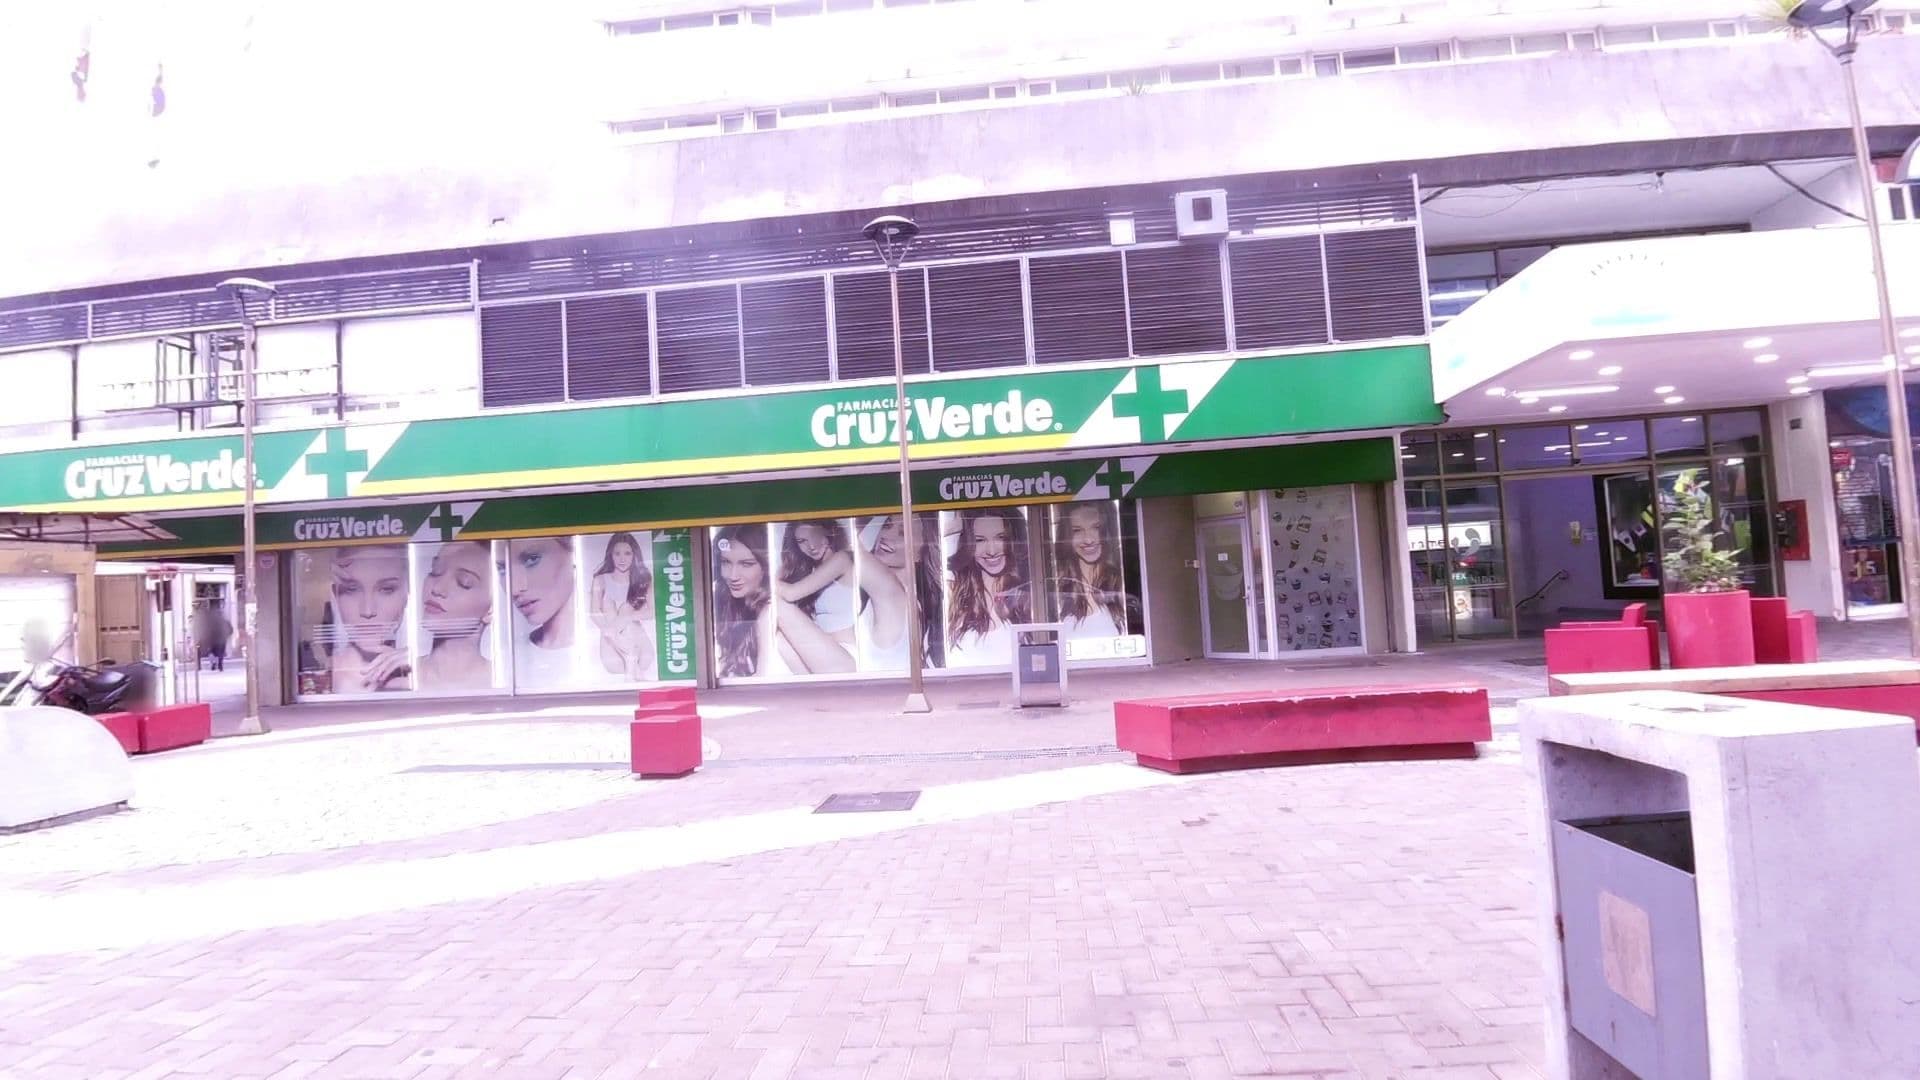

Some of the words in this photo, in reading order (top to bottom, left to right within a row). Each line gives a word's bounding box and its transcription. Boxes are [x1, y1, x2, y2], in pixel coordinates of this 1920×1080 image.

[914, 390, 1053, 440] Verde
[64, 459, 145, 499] Cruz
[145, 448, 257, 494] Verde
[939, 477, 993, 500] Cruz
[993, 471, 1067, 497] Verde
[294, 519, 340, 540] Cruz
[340, 514, 403, 538] Verde
[663, 552, 686, 621] Verde
[667, 621, 688, 673] Cruz
